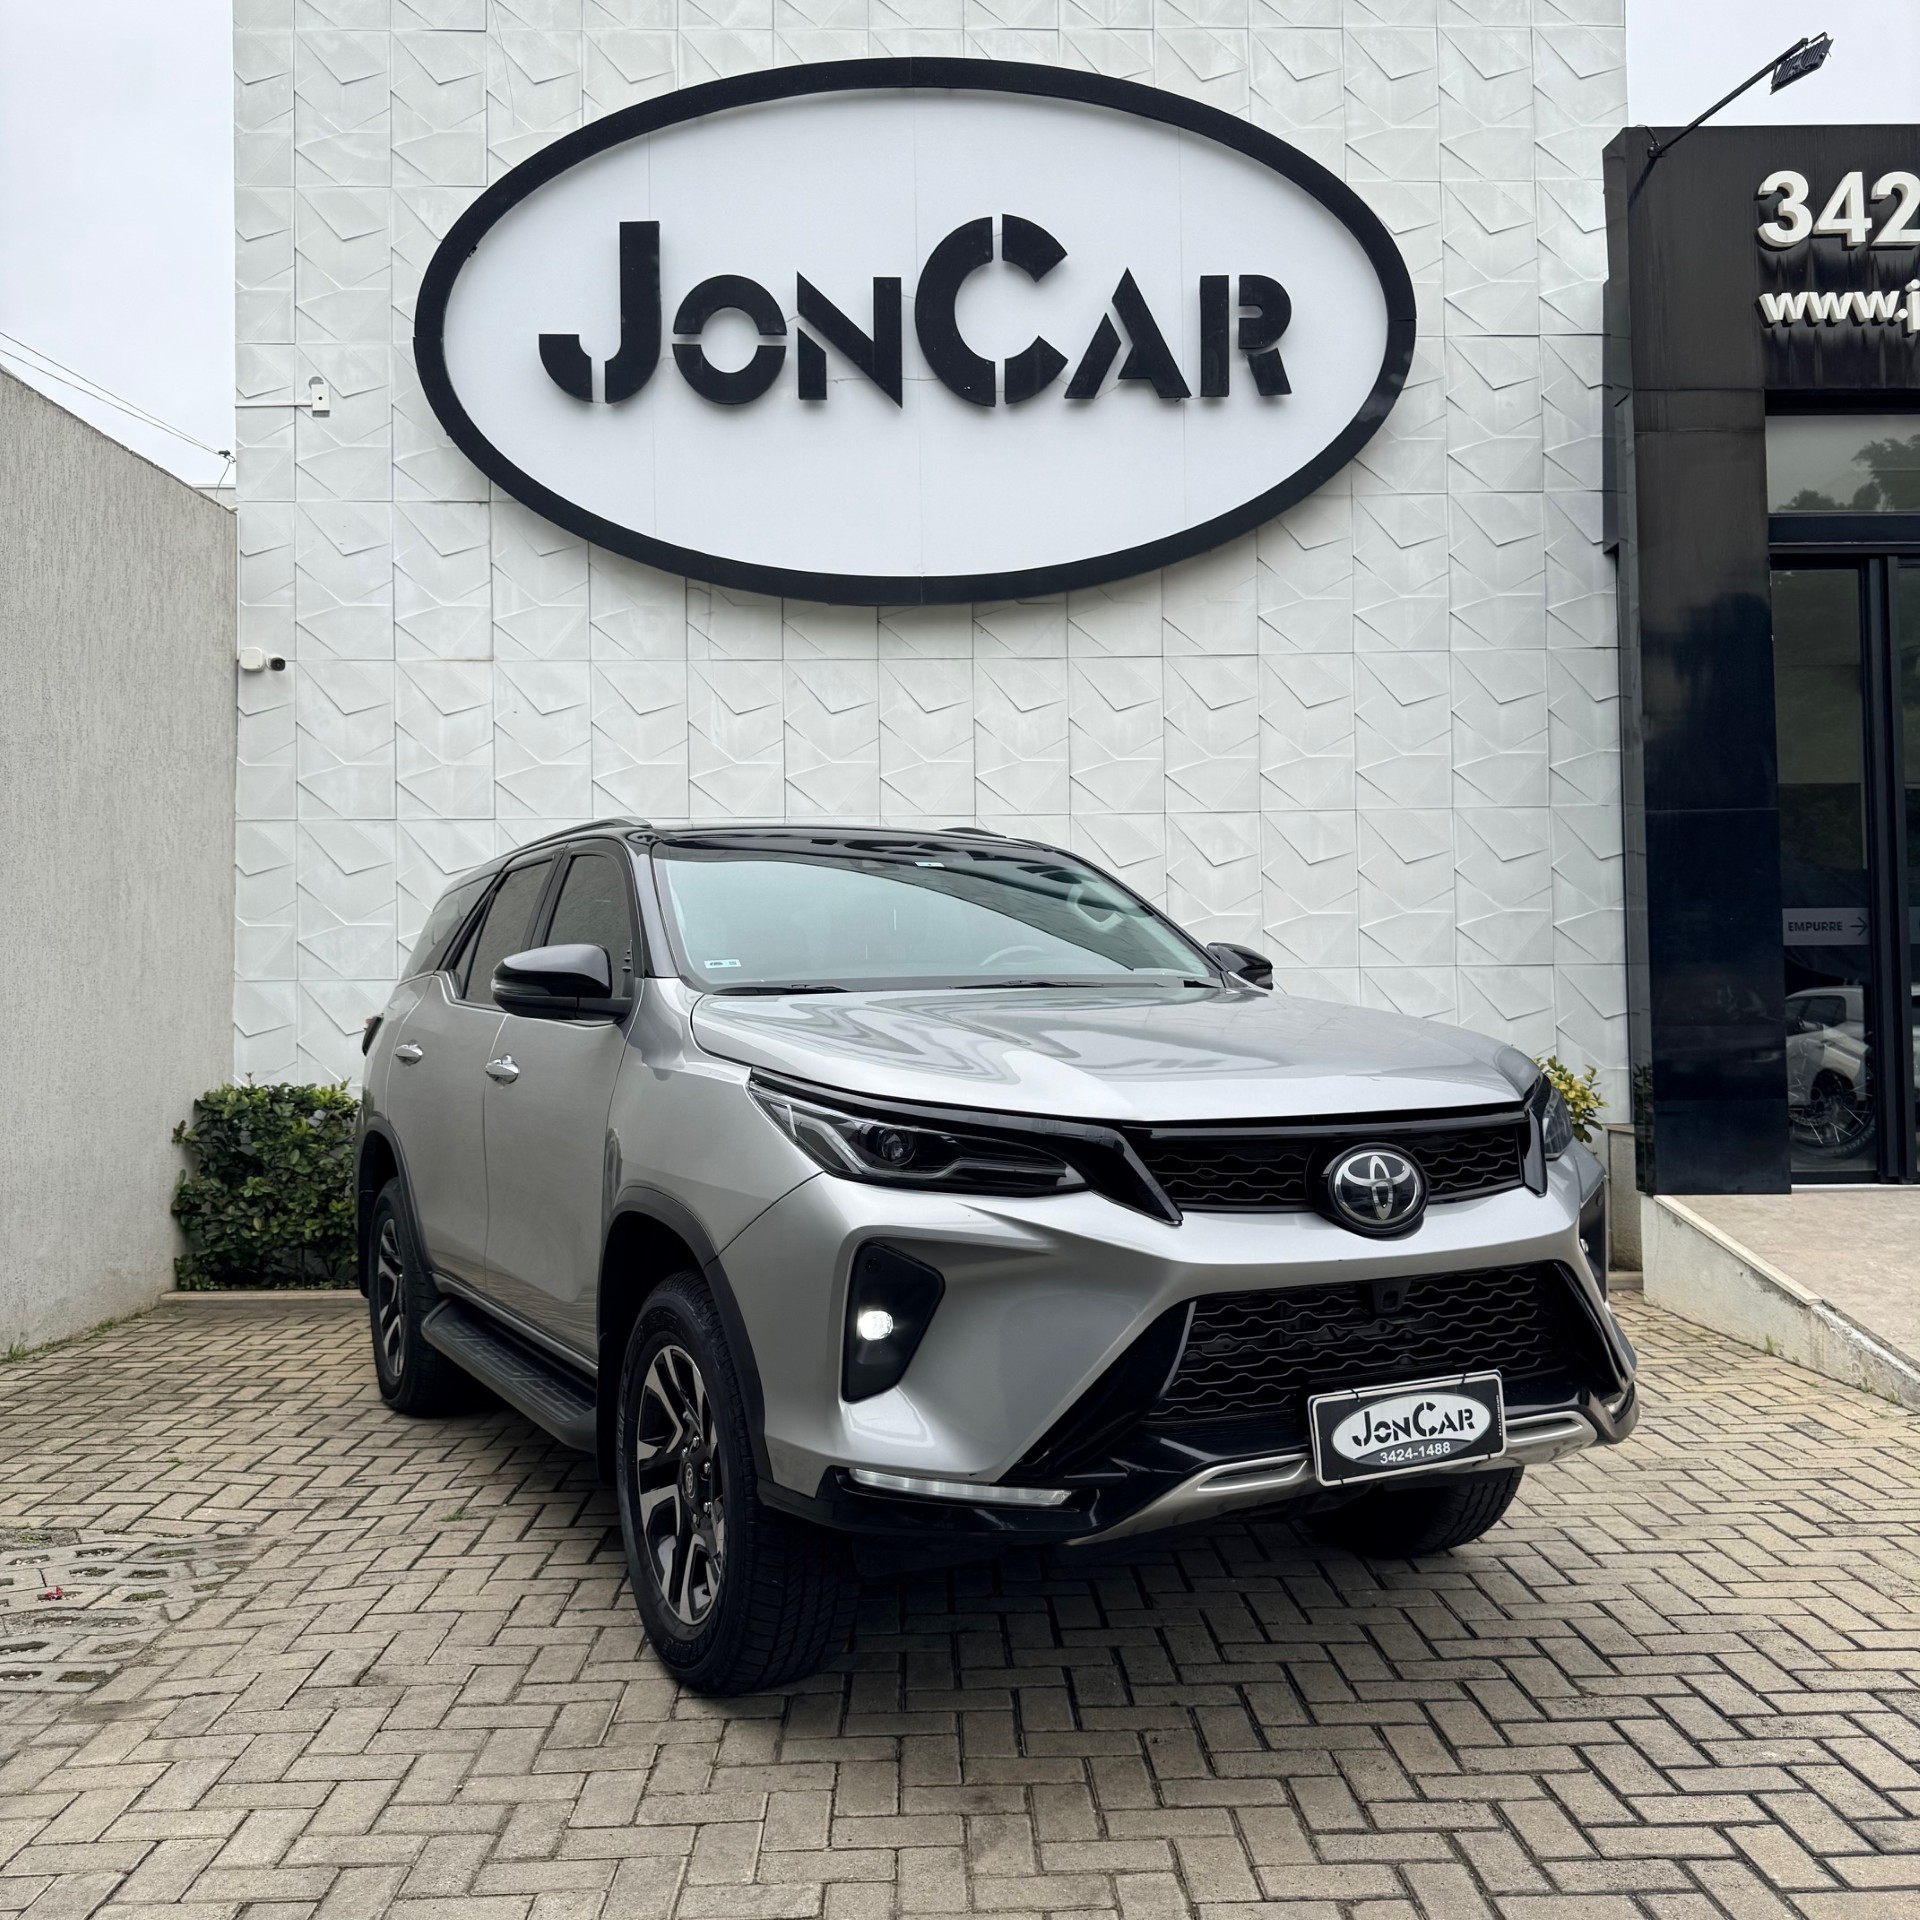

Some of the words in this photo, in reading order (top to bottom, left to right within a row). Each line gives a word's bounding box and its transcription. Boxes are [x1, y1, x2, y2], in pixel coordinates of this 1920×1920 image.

[1758, 170, 1920, 247] 342
[1787, 921, 1844, 932] EMPURRE
[1379, 1441, 1451, 1465] 3424-1488
